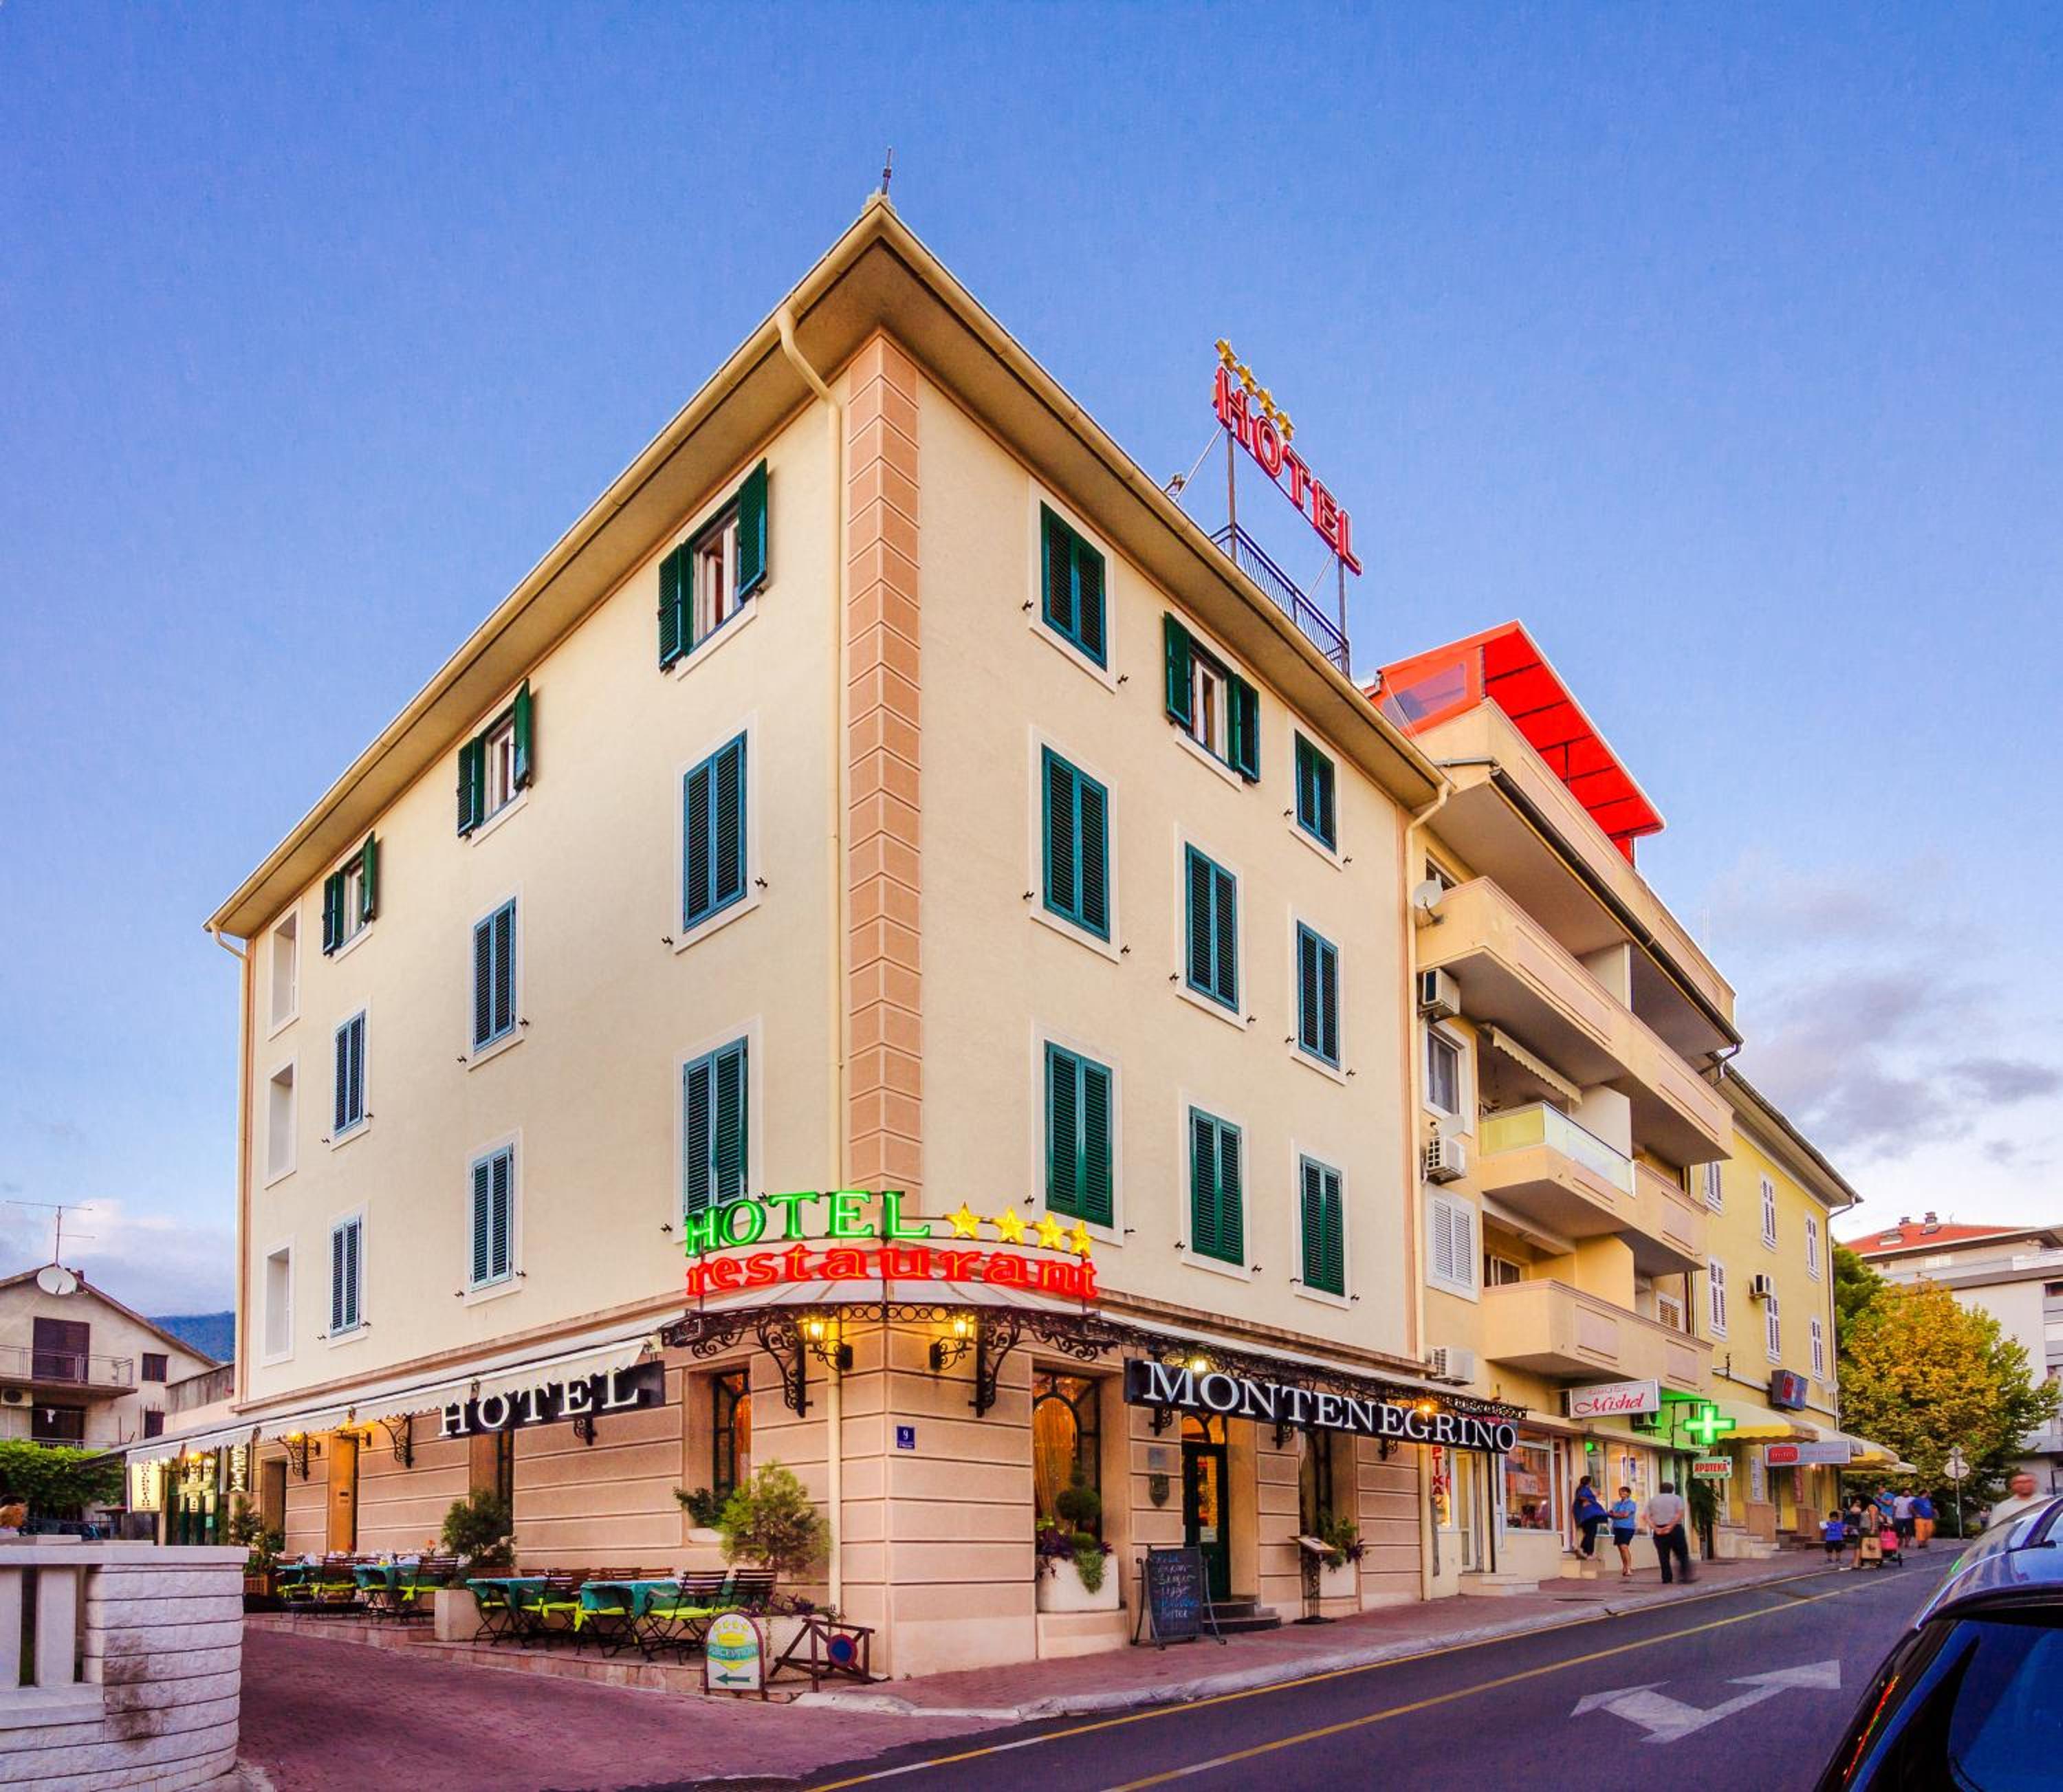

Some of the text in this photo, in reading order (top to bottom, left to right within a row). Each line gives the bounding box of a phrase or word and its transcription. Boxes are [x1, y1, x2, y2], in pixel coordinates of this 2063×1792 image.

[1214, 365, 1363, 576] HOTEL
[685, 1190, 930, 1257] HOTEL
[686, 1243, 1099, 1299] restaurant
[438, 1368, 639, 1437] HOTEL
[903, 1429, 908, 1441] 9
[1142, 1360, 1517, 1452] MONTENEGRINO
[1432, 1445, 1443, 1496] PTIKA
